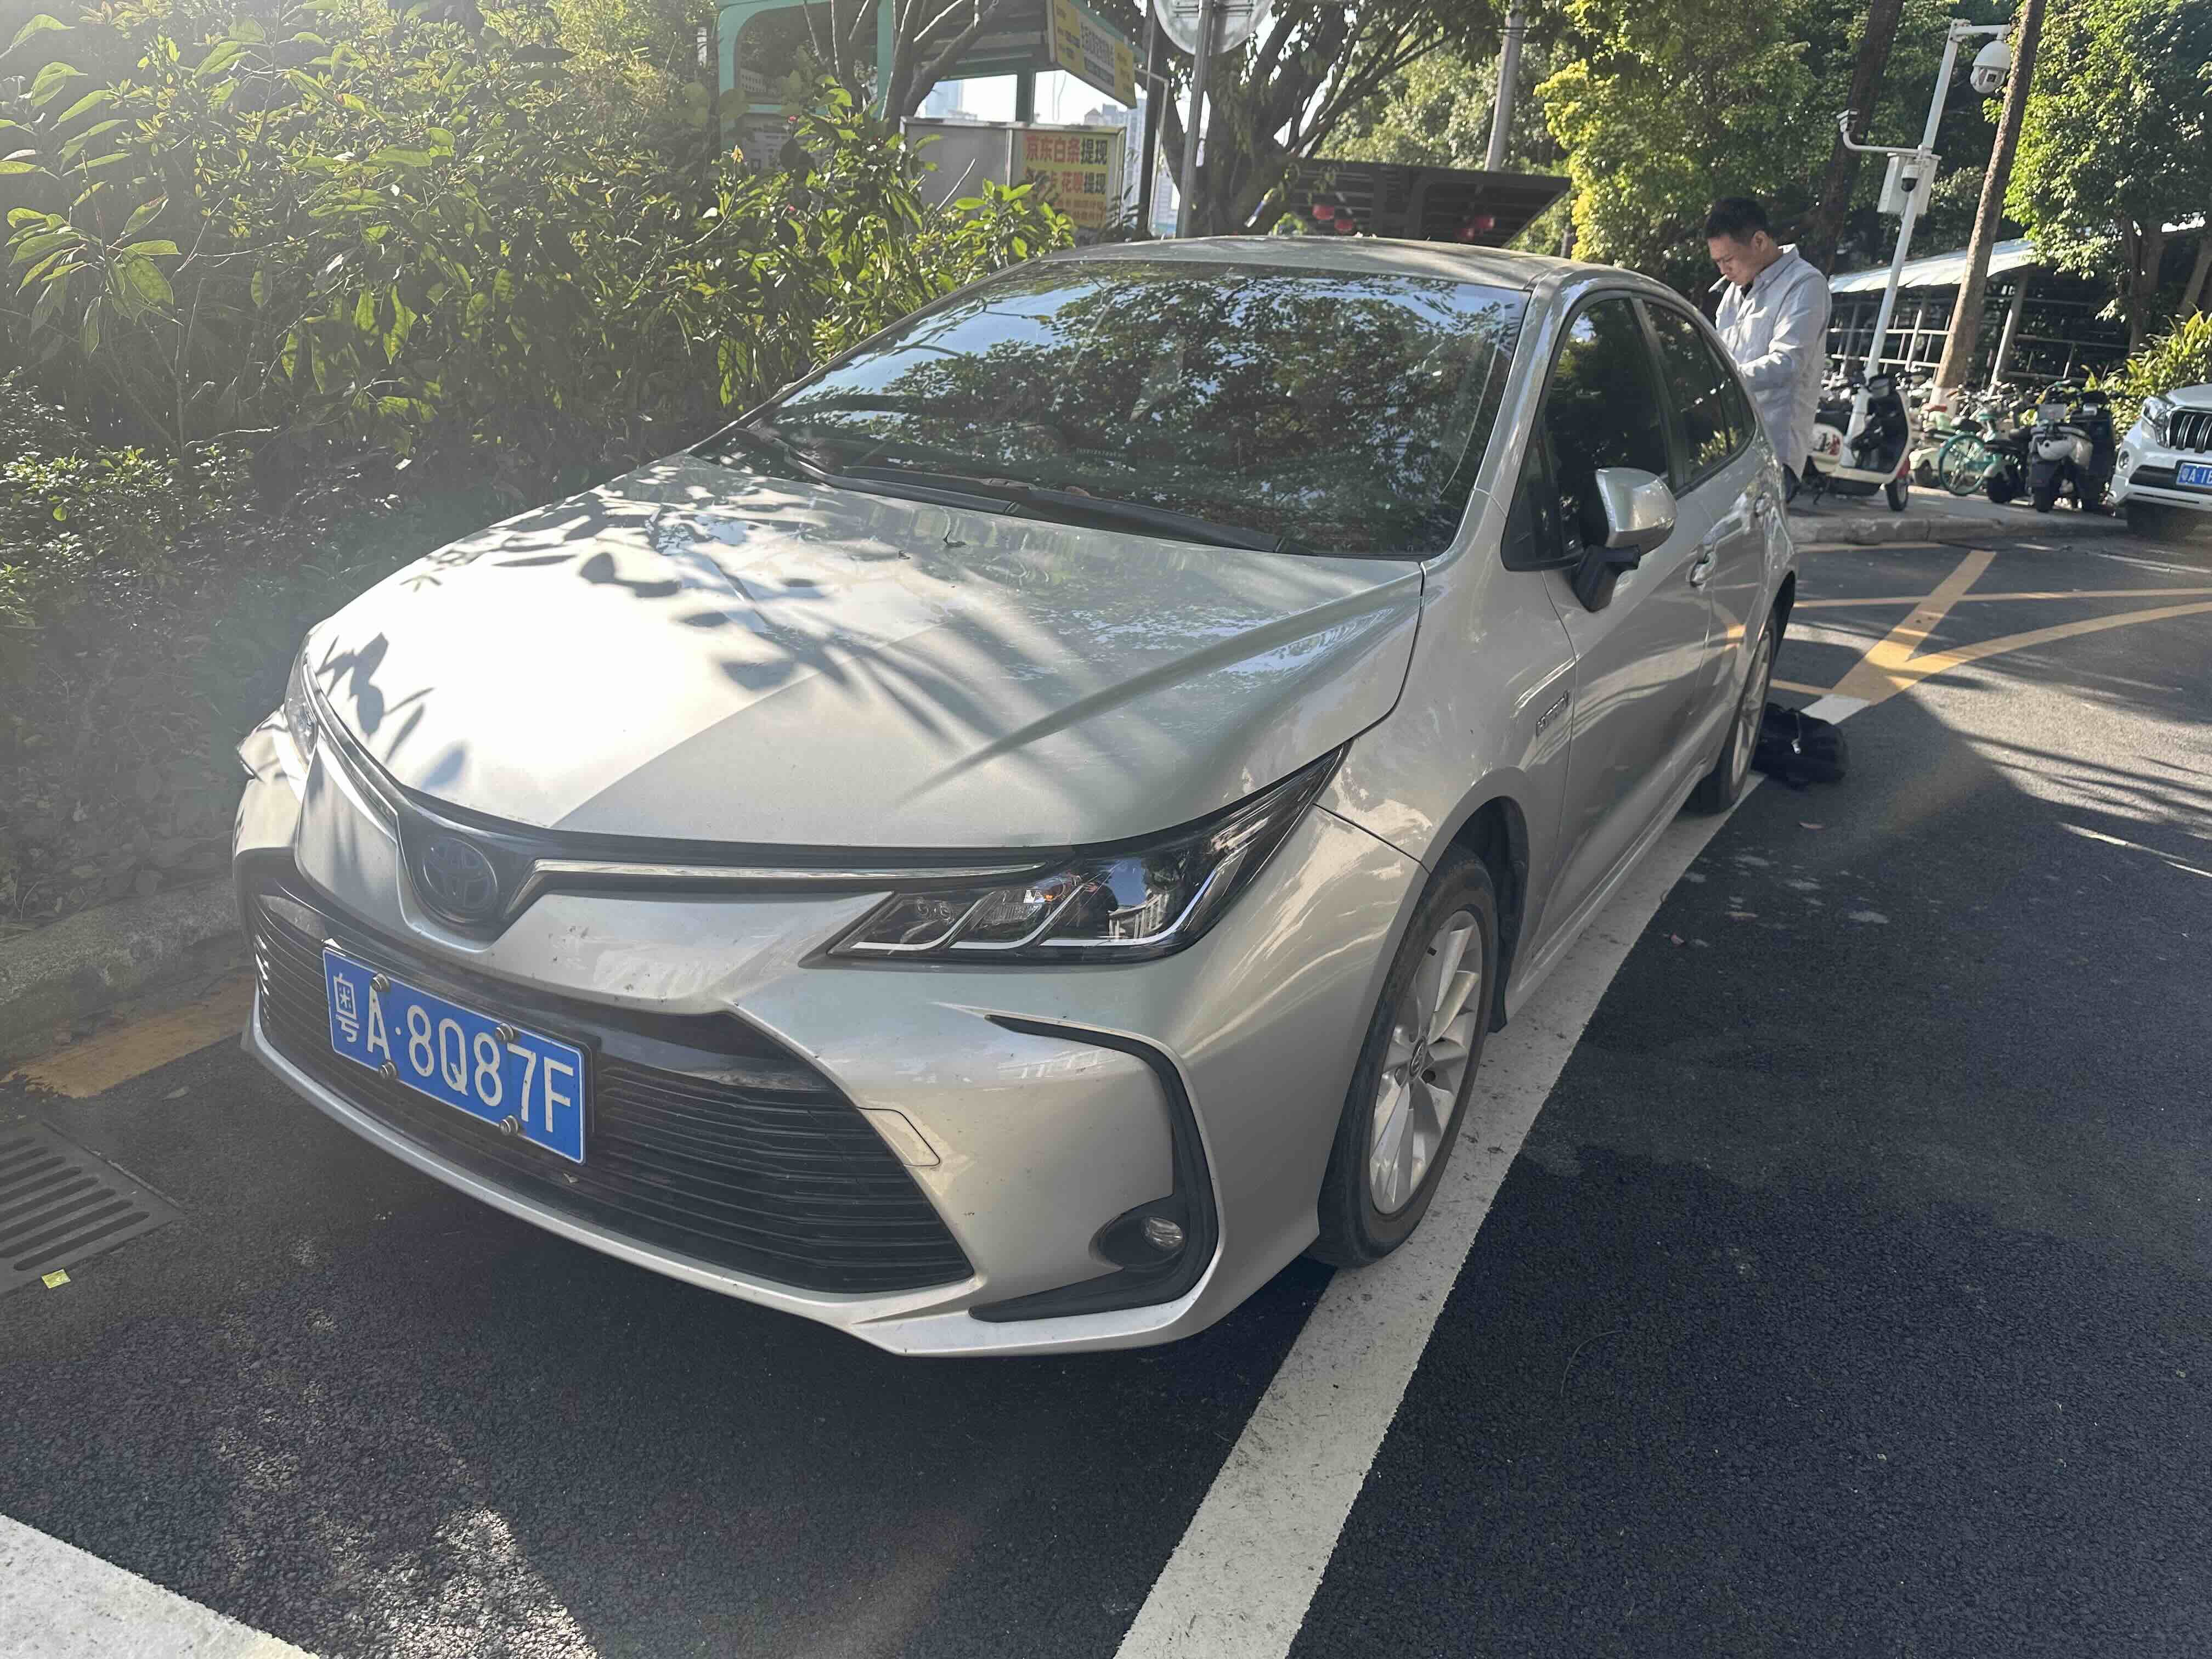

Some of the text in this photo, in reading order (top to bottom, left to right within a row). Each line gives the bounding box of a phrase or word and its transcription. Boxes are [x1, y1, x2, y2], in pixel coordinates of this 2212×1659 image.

[1026, 136, 1108, 164] 京东白条提现
